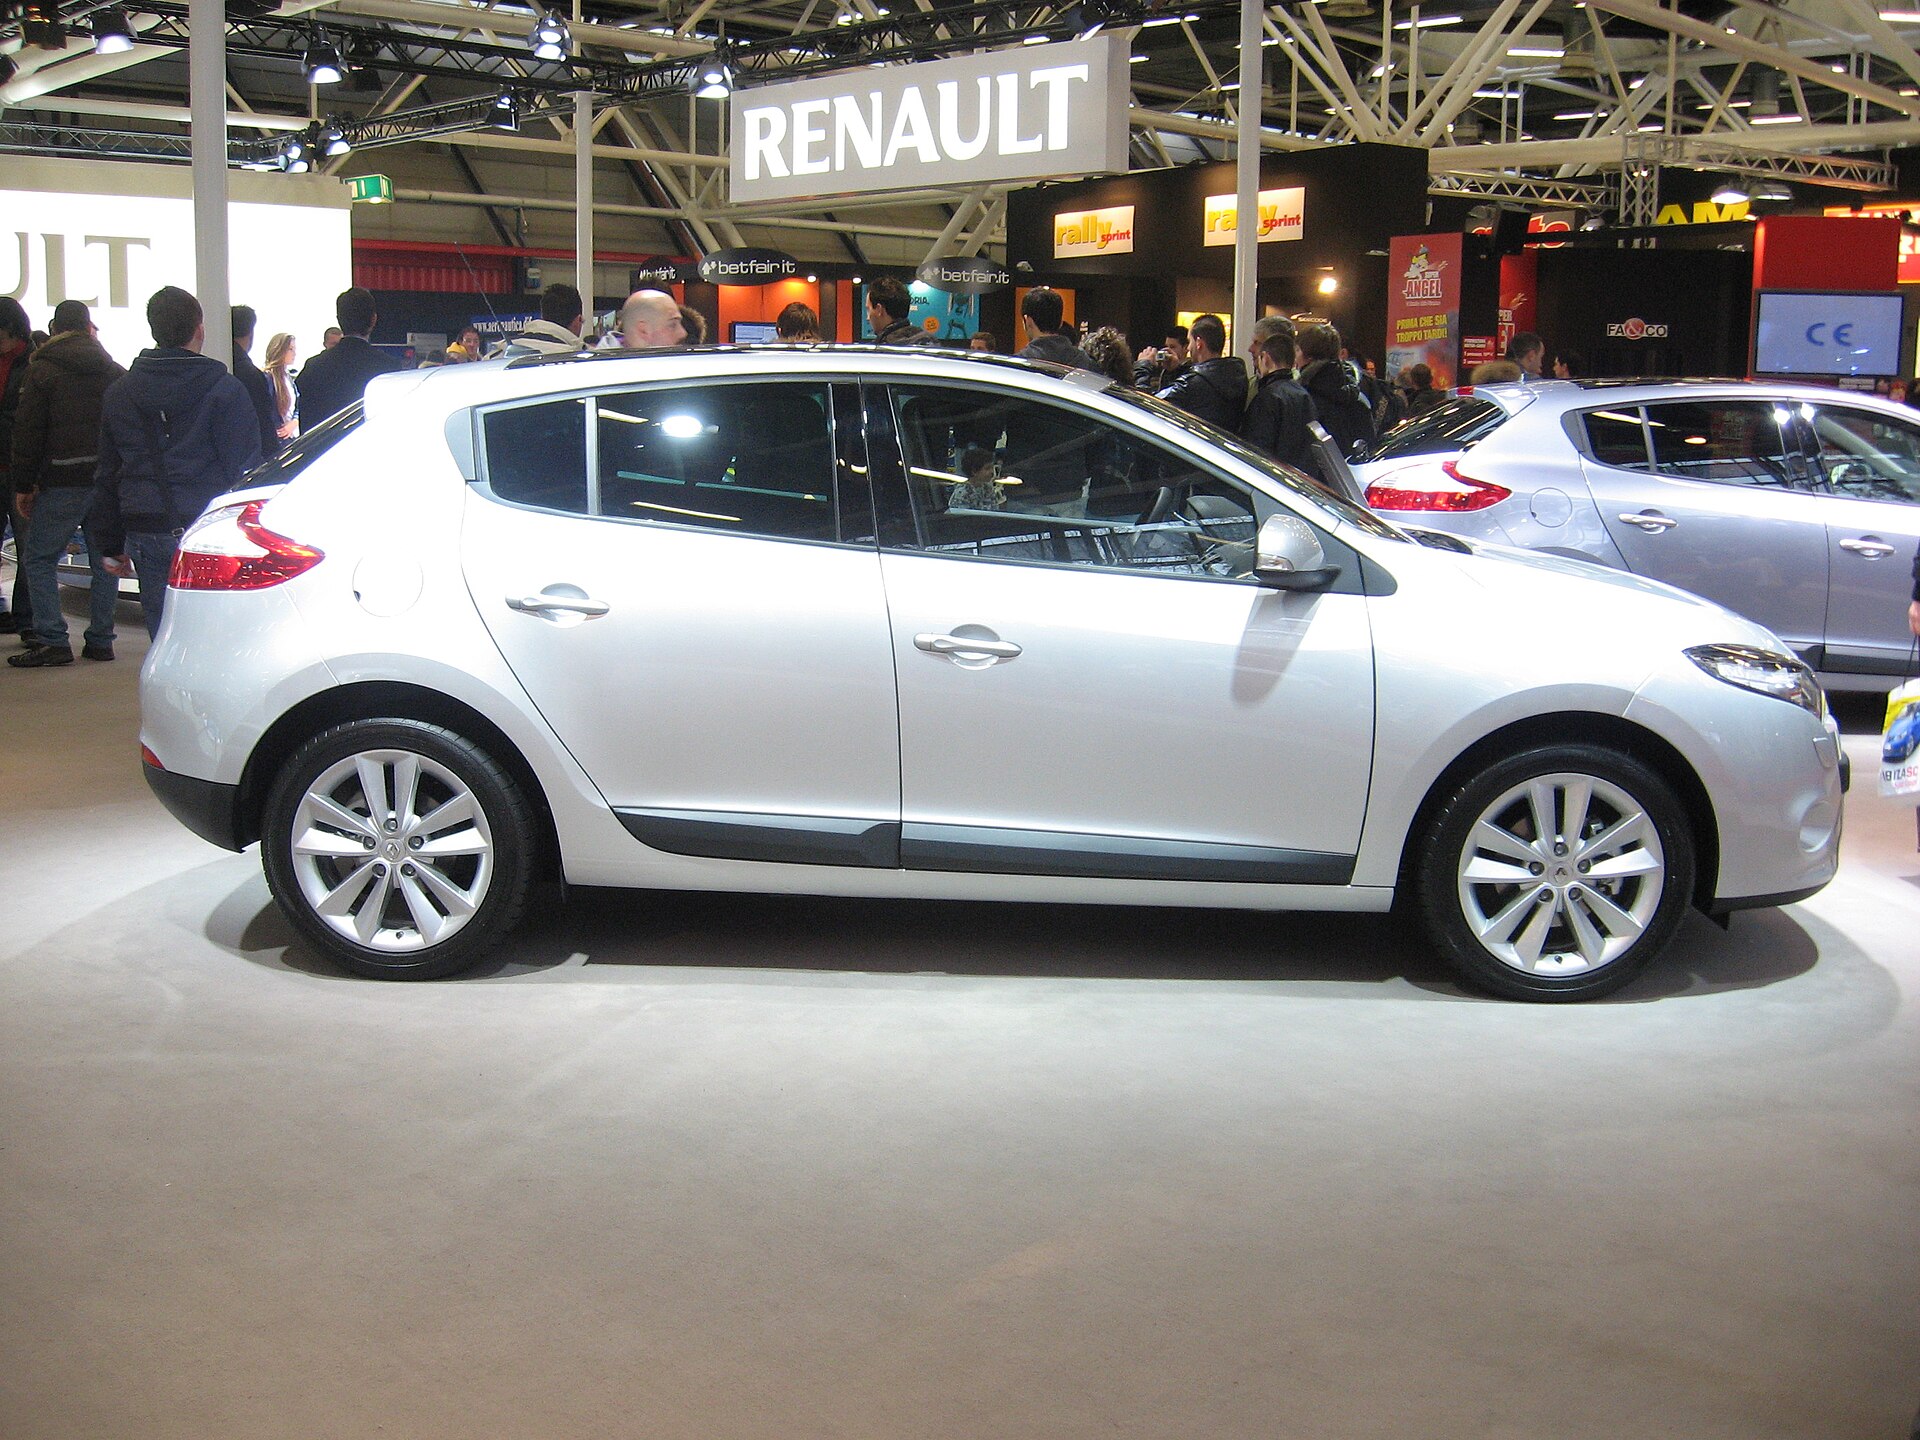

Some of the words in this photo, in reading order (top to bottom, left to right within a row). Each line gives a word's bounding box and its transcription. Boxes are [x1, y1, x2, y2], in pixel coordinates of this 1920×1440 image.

[743, 64, 1088, 181] RENAULT
[1207, 204, 1277, 236] ray
[1263, 214, 1301, 229] sprint
[1056, 215, 1112, 249] rally
[1100, 229, 1131, 243] sprint
[941, 267, 1010, 284] betfair.it
[1405, 278, 1442, 299] ANGEL
[1396, 317, 1419, 330] PRIMA
[1420, 315, 1434, 328] CHE
[1434, 314, 1447, 326] SIA
[1396, 330, 1422, 343] TROPPO
[1805, 322, 1853, 347] CE
